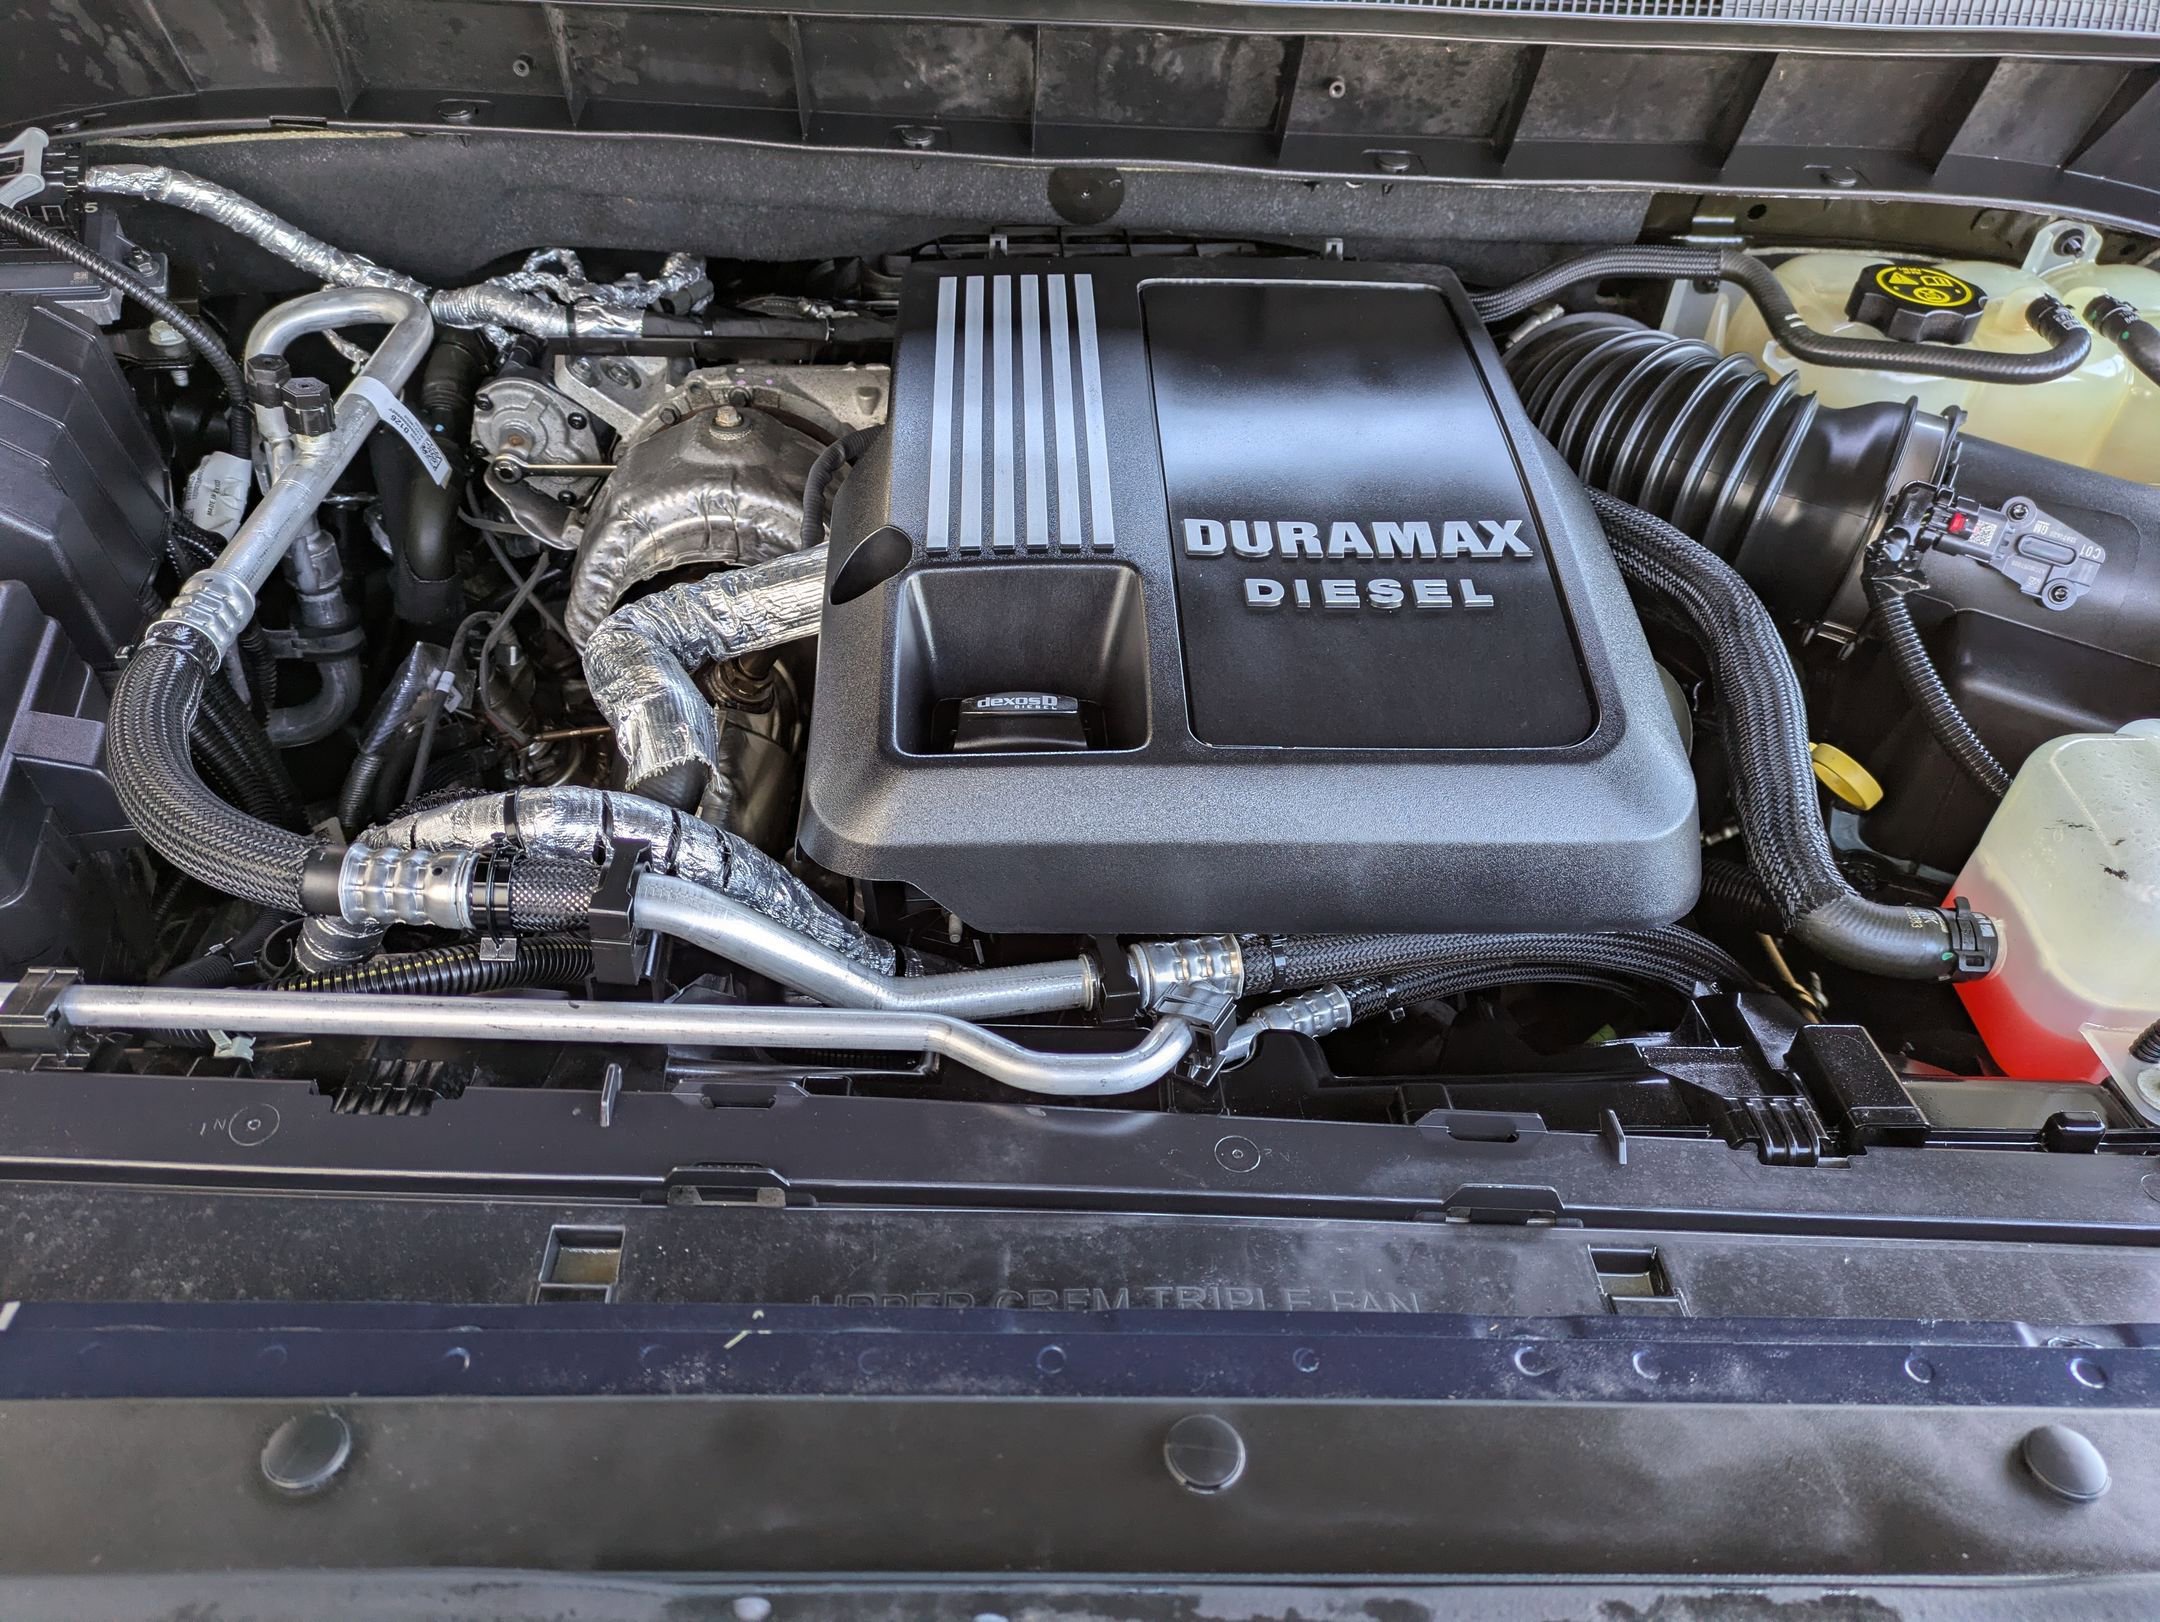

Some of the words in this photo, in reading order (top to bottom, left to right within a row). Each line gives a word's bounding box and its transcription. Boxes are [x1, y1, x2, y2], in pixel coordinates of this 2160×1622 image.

[1184, 518, 1533, 558] DURAMAX
[1245, 578, 1494, 609] DIESEL
[1328, 1289, 1420, 1312] FAN
